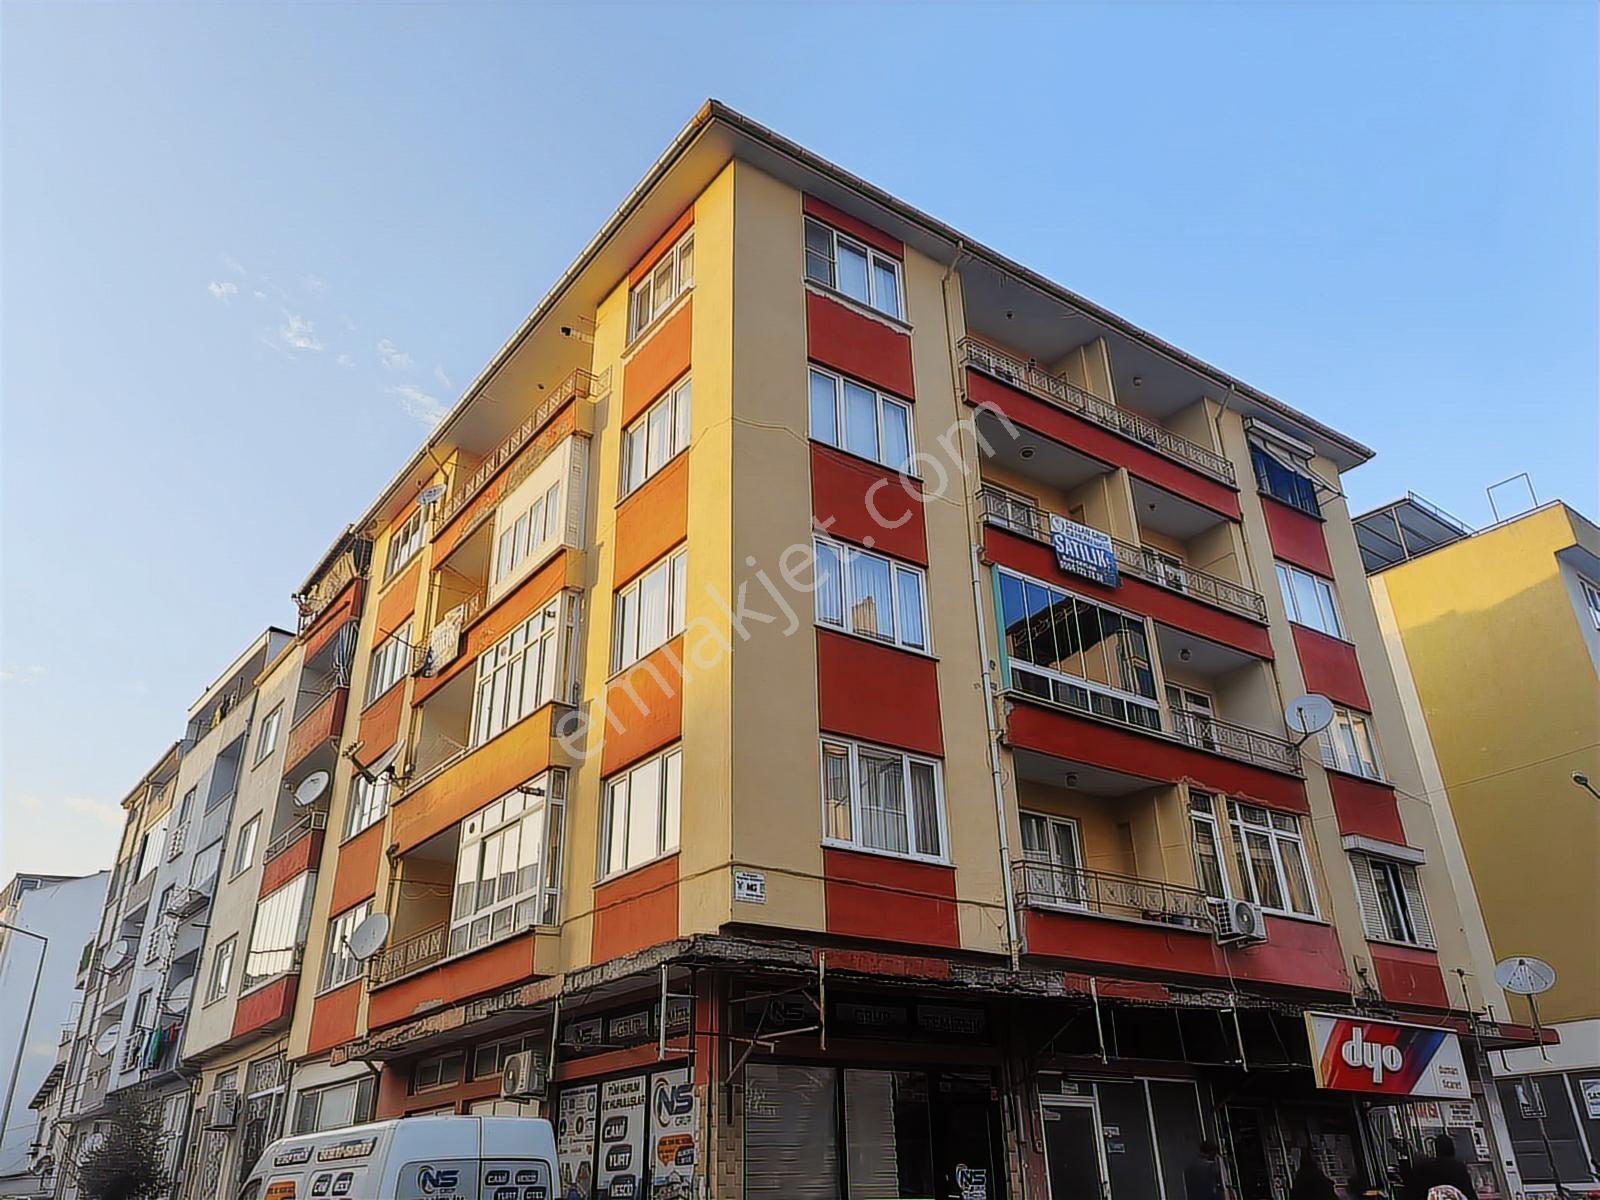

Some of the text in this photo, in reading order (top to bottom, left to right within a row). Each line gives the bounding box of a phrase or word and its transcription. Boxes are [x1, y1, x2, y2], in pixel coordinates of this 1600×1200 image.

[1342, 1027, 1402, 1083] dyo
[660, 1084, 693, 1115] NS
[422, 1170, 459, 1188] NS
